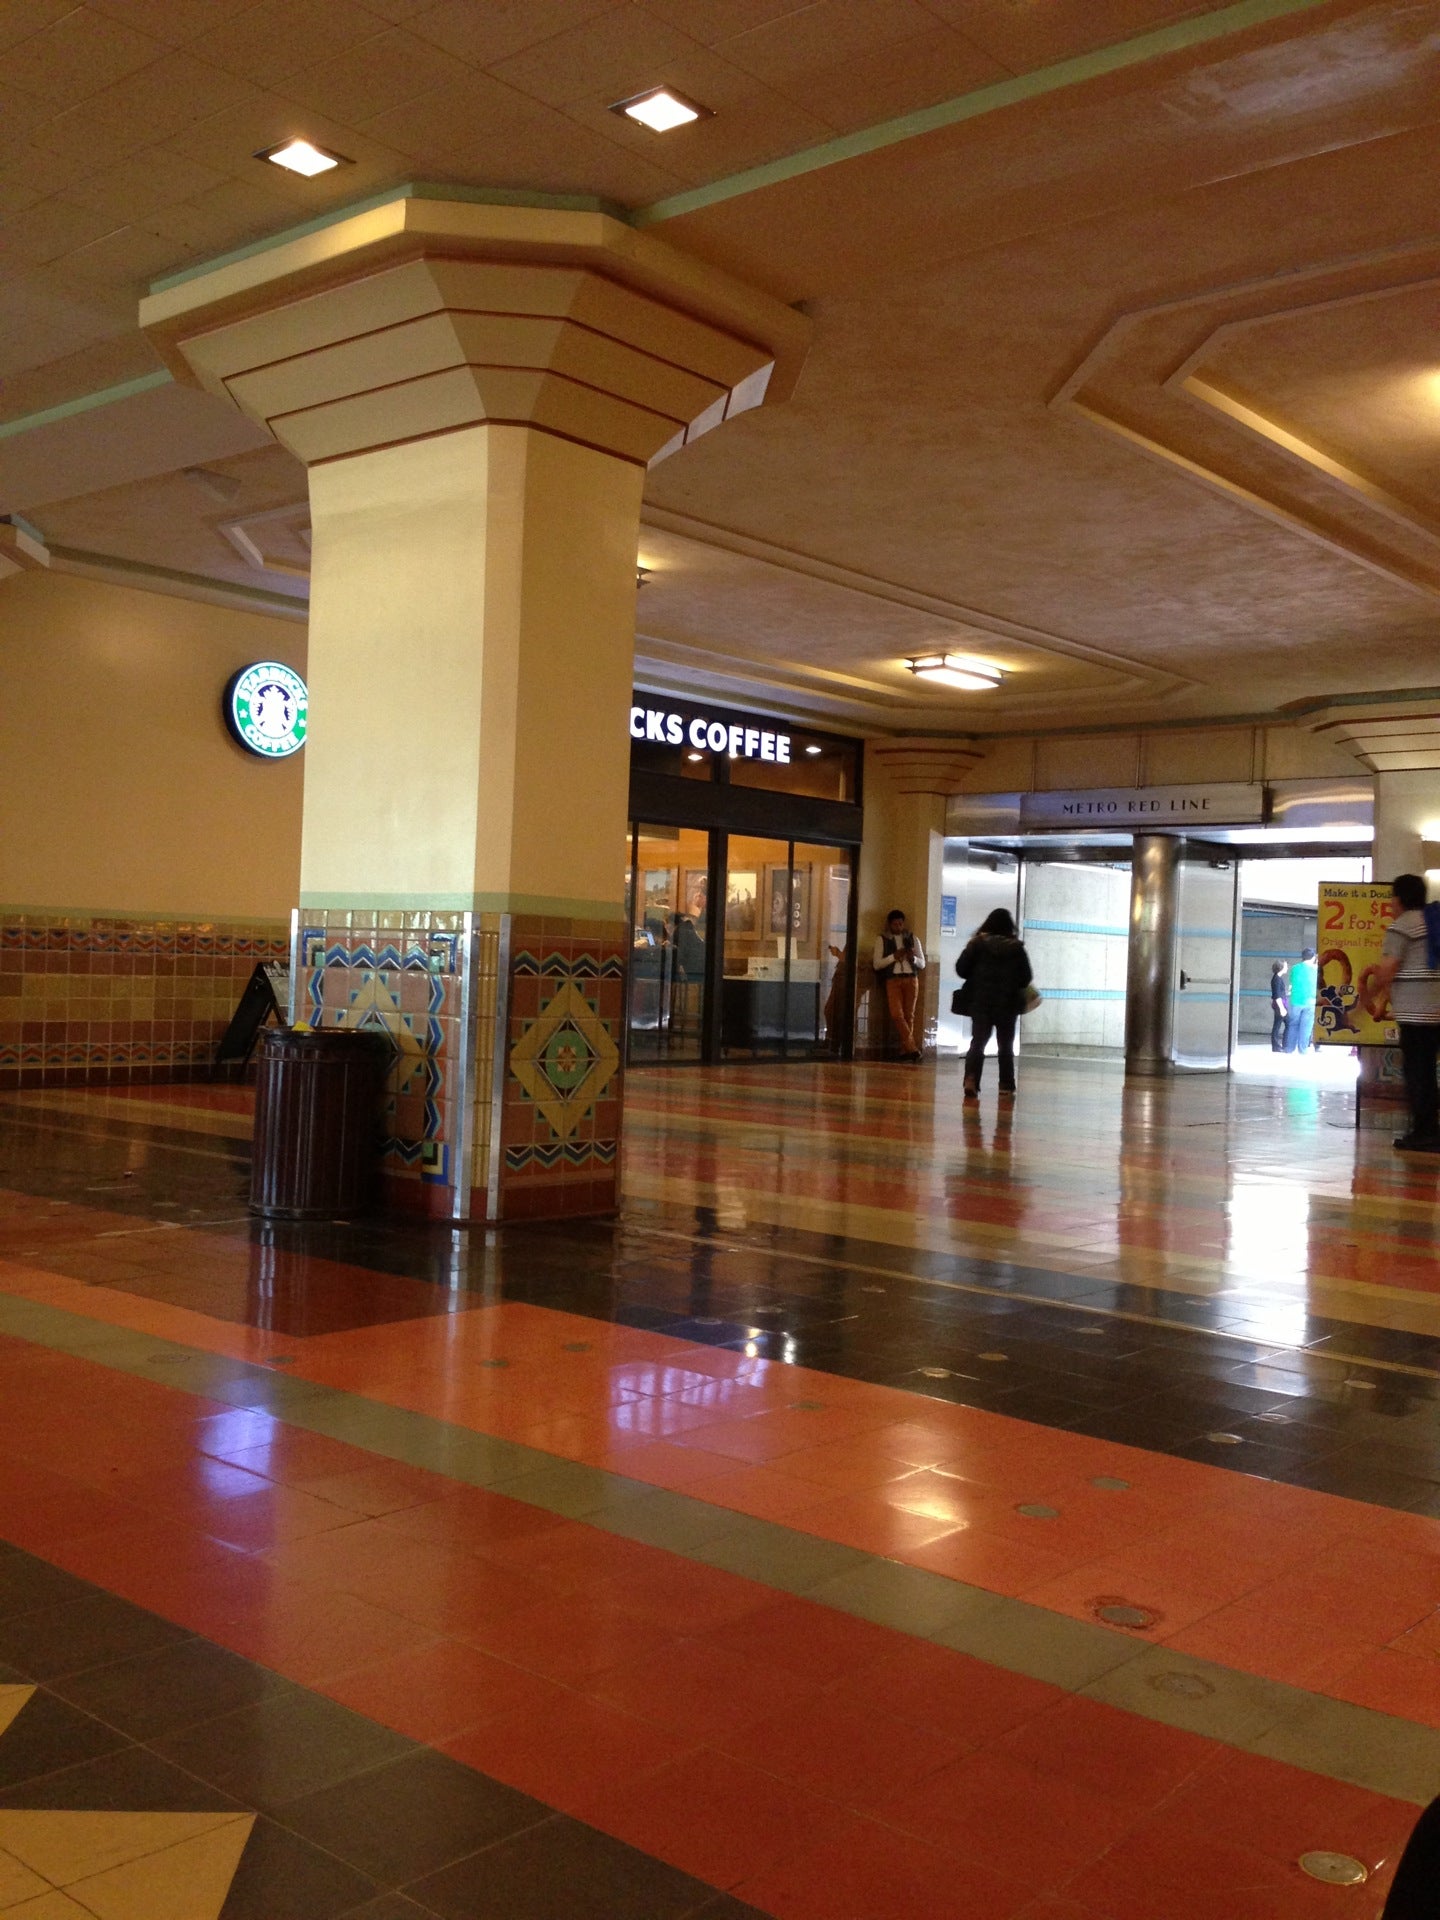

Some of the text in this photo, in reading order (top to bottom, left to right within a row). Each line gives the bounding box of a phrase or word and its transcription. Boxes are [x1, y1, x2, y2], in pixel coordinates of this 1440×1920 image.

[689, 719, 790, 763] COFFEE
[1063, 798, 1211, 814] METRO RED LINE
[1324, 888, 1348, 898] Make
[1351, 889, 1359, 897] it
[1324, 900, 1345, 930] 2
[1348, 914, 1375, 930] for
[1321, 937, 1362, 949] Original
